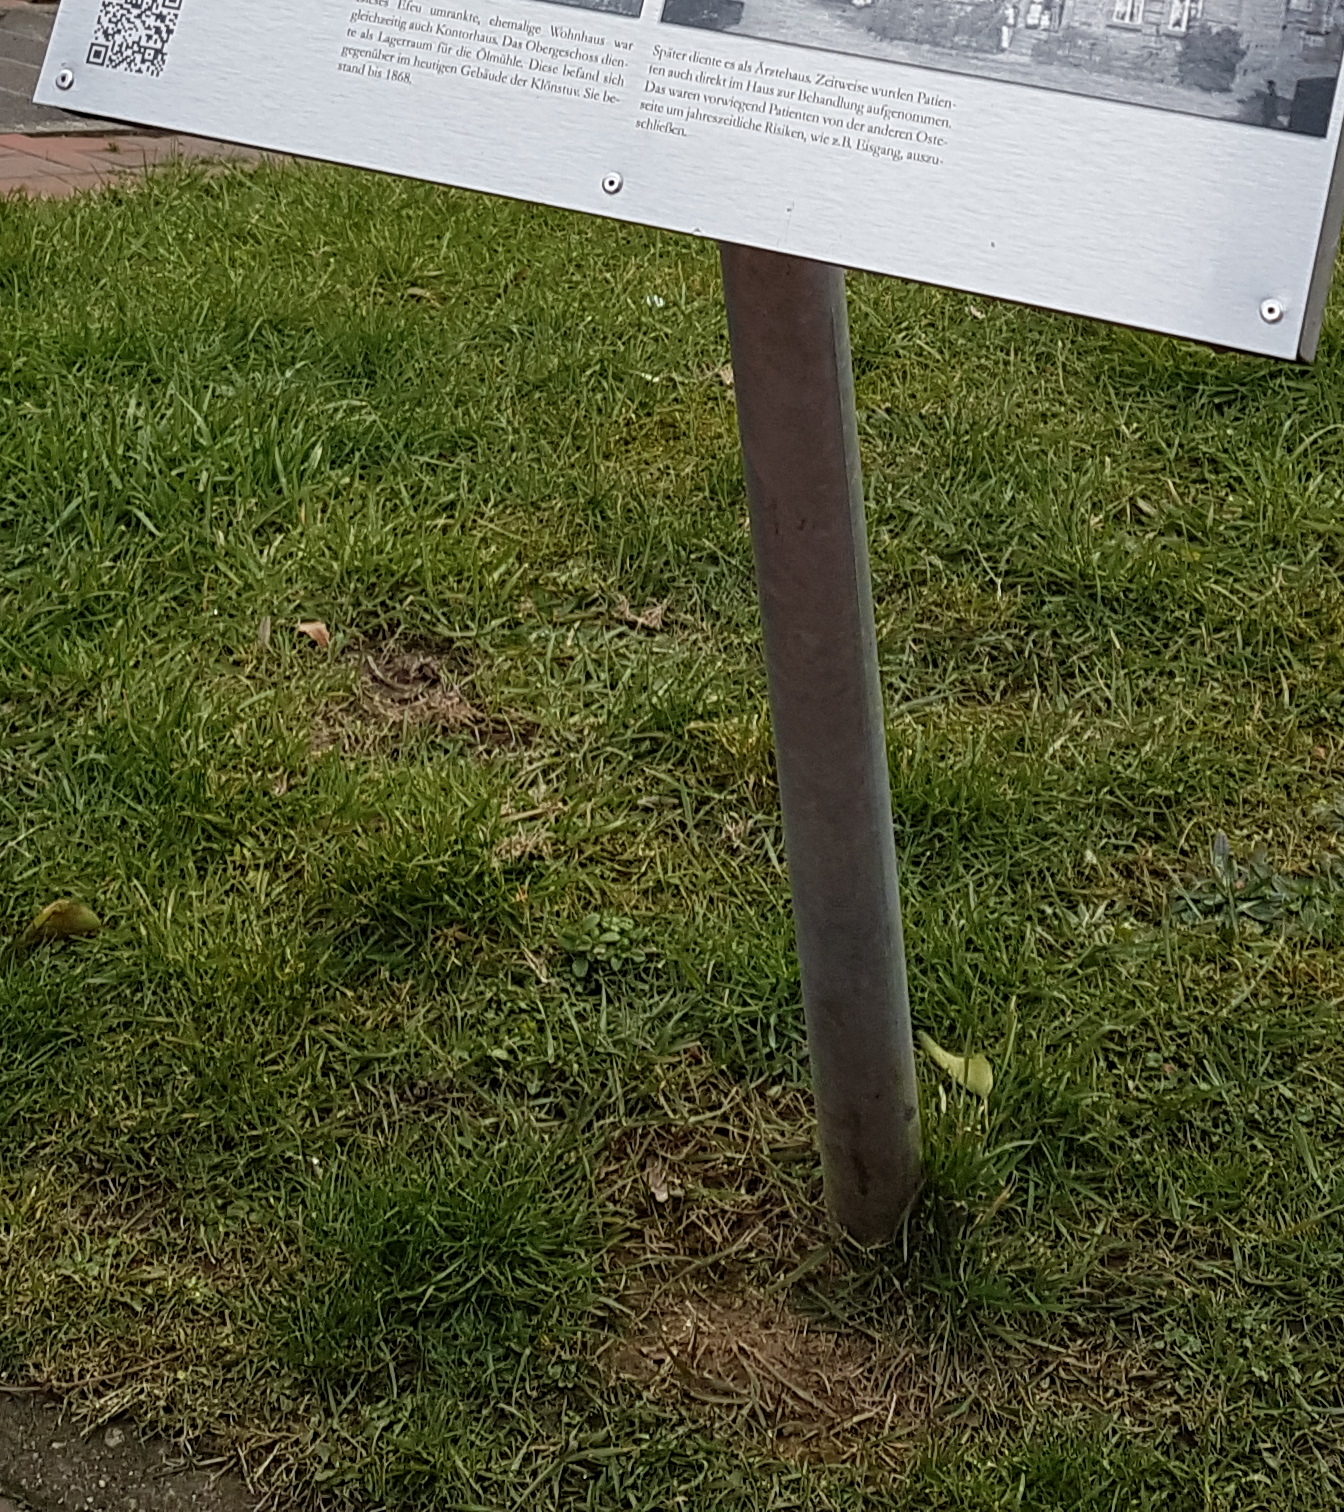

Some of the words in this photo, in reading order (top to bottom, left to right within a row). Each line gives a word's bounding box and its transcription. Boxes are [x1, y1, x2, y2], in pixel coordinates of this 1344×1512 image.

[346, 28, 357, 38] te
[359, 28, 374, 41] als
[377, 30, 433, 52] Lagerraum
[436, 41, 453, 55] für
[455, 45, 472, 59] die
[476, 47, 524, 69] Ölmühle.
[528, 57, 559, 74] Diese
[562, 63, 600, 83] befand
[603, 72, 625, 87] sich
[349, 9, 407, 32] gleichzeitig
[408, 21, 433, 33] auch
[501, 35, 523, 50] Das
[525, 39, 599, 63] Obergeschoss
[600, 53, 629, 68] dien-
[429, 7, 481, 26] umrankte,
[488, 15, 542, 37] ehemalige
[550, 24, 605, 46] Wohnhaus
[614, 39, 634, 51] war
[337, 62, 366, 76] stand
[367, 64, 382, 79] bis
[340, 46, 396, 63] gegenüber
[396, 52, 411, 66] im
[412, 55, 458, 75] heutigen
[460, 64, 508, 84] Gebäude
[509, 73, 528, 87] der
[583, 87, 600, 101] Sie
[602, 89, 620, 104] be-
[648, 64, 666, 77] ten
[667, 68, 693, 82] auch
[694, 70, 727, 88] direkt
[728, 76, 743, 91] im
[746, 79, 775, 96] Haus
[776, 88, 796, 99] zur
[797, 88, 865, 116] Behandlung
[866, 104, 952, 129] aufgenommen.
[652, 44, 688, 61] Später
[688, 50, 722, 67] diente
[723, 61, 736, 70] es
[737, 60, 752, 73] als
[815, 73, 869, 94] Zeitweise
[871, 87, 914, 103] wurden
[917, 91, 956, 109] Patien-
[639, 101, 664, 113] seite
[666, 106, 684, 117] um
[684, 106, 762, 132] jahreszeitliche
[764, 121, 807, 143] Risiken,
[810, 131, 830, 145] wie
[856, 138, 904, 162] Eisgang,
[906, 151, 944, 165] auszu-
[644, 80, 666, 95] Das
[668, 88, 701, 102] waren
[703, 94, 767, 114] vorwiegend
[768, 102, 820, 123] Patienten
[822, 116, 844, 128] von
[846, 117, 865, 132] der
[867, 124, 913, 141] anderen
[915, 130, 948, 147] Oste-
